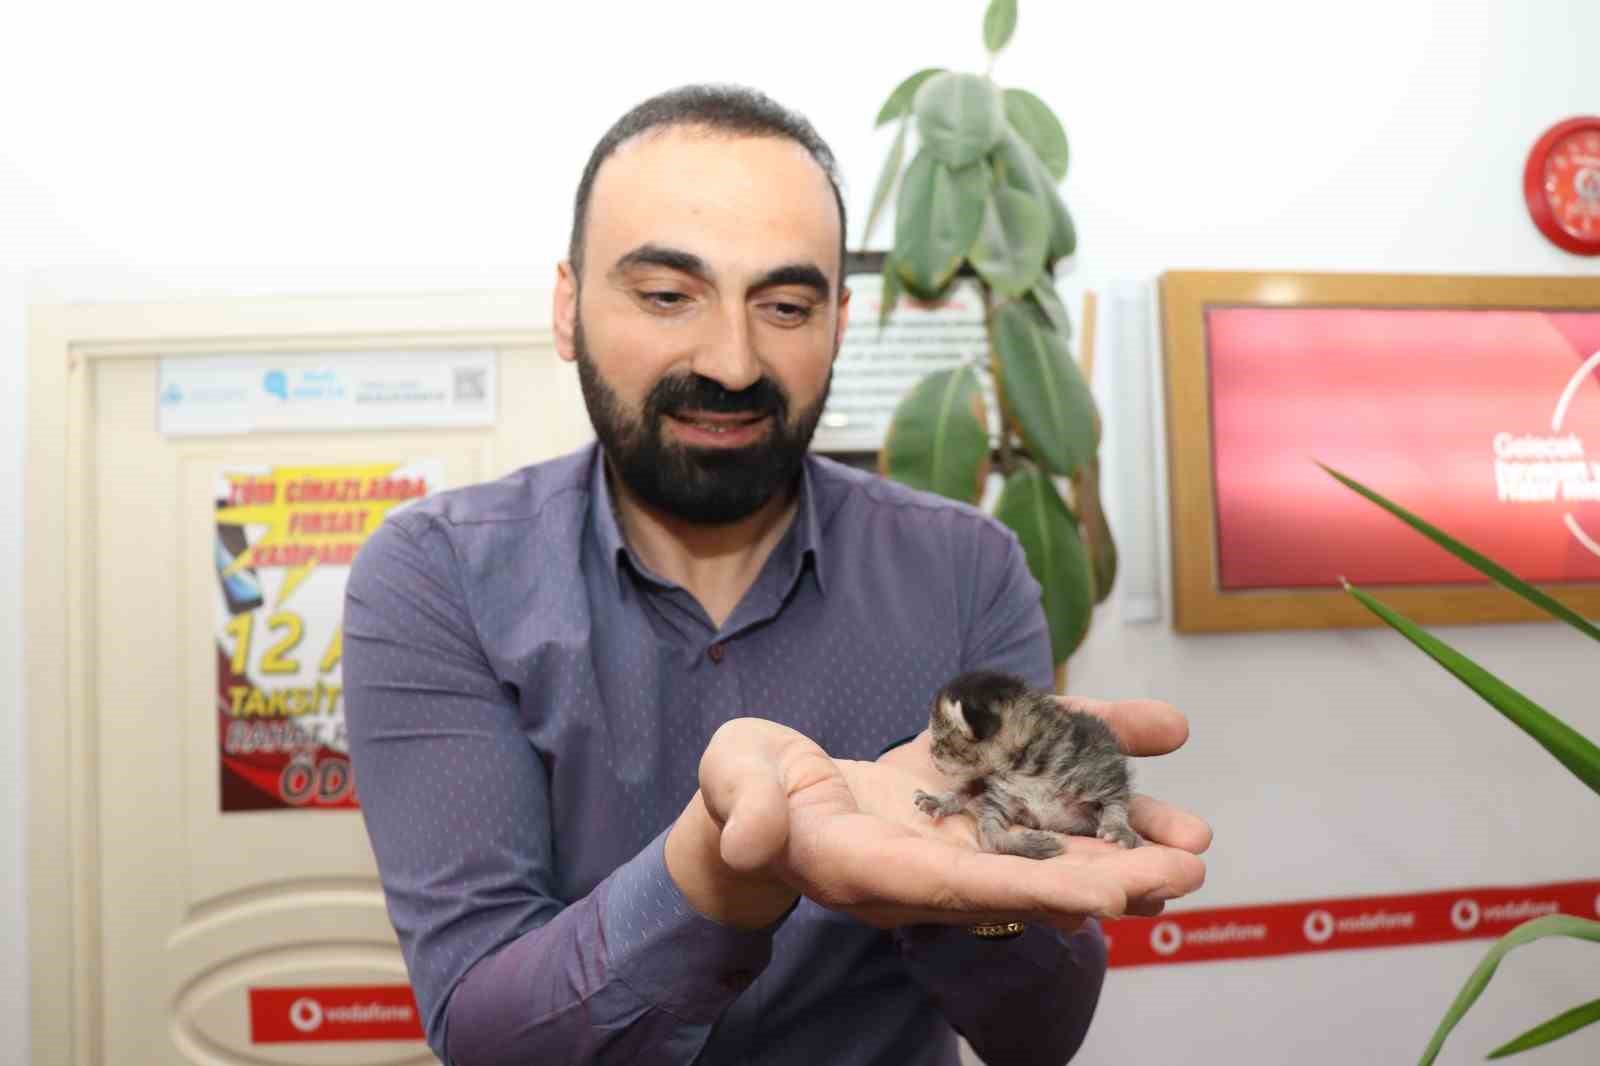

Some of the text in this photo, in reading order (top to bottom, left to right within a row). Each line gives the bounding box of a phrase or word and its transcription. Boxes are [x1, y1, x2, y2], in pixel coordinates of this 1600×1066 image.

[289, 510, 368, 533] FIRSAT
[226, 612, 303, 674] 12
[281, 751, 353, 803] ÖD
[1486, 901, 1558, 920] vodafone
[1338, 912, 1413, 933] vodafone
[1185, 925, 1266, 944] vodafone
[327, 1003, 411, 1022] vodafone
